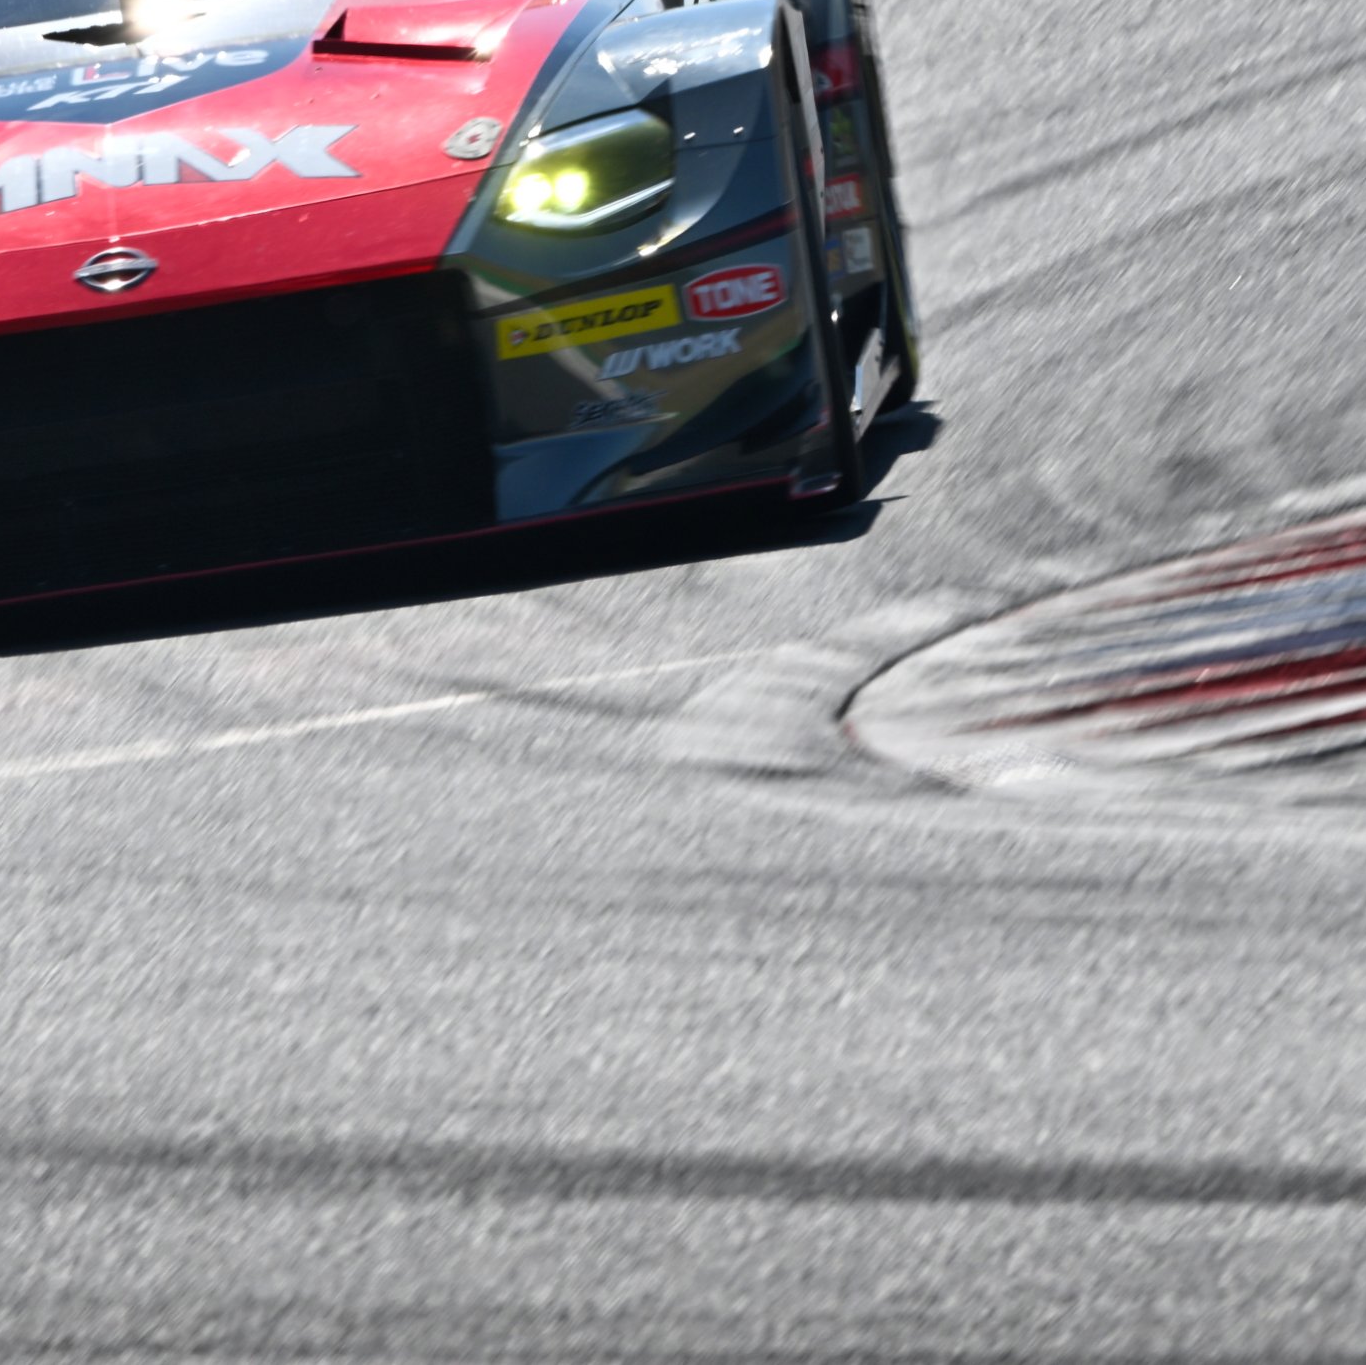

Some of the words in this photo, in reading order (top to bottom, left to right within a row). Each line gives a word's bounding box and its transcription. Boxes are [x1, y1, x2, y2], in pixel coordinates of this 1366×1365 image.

[692, 271, 779, 314] TONE
[532, 298, 664, 343] DUNLOP
[641, 326, 742, 371] WORK
